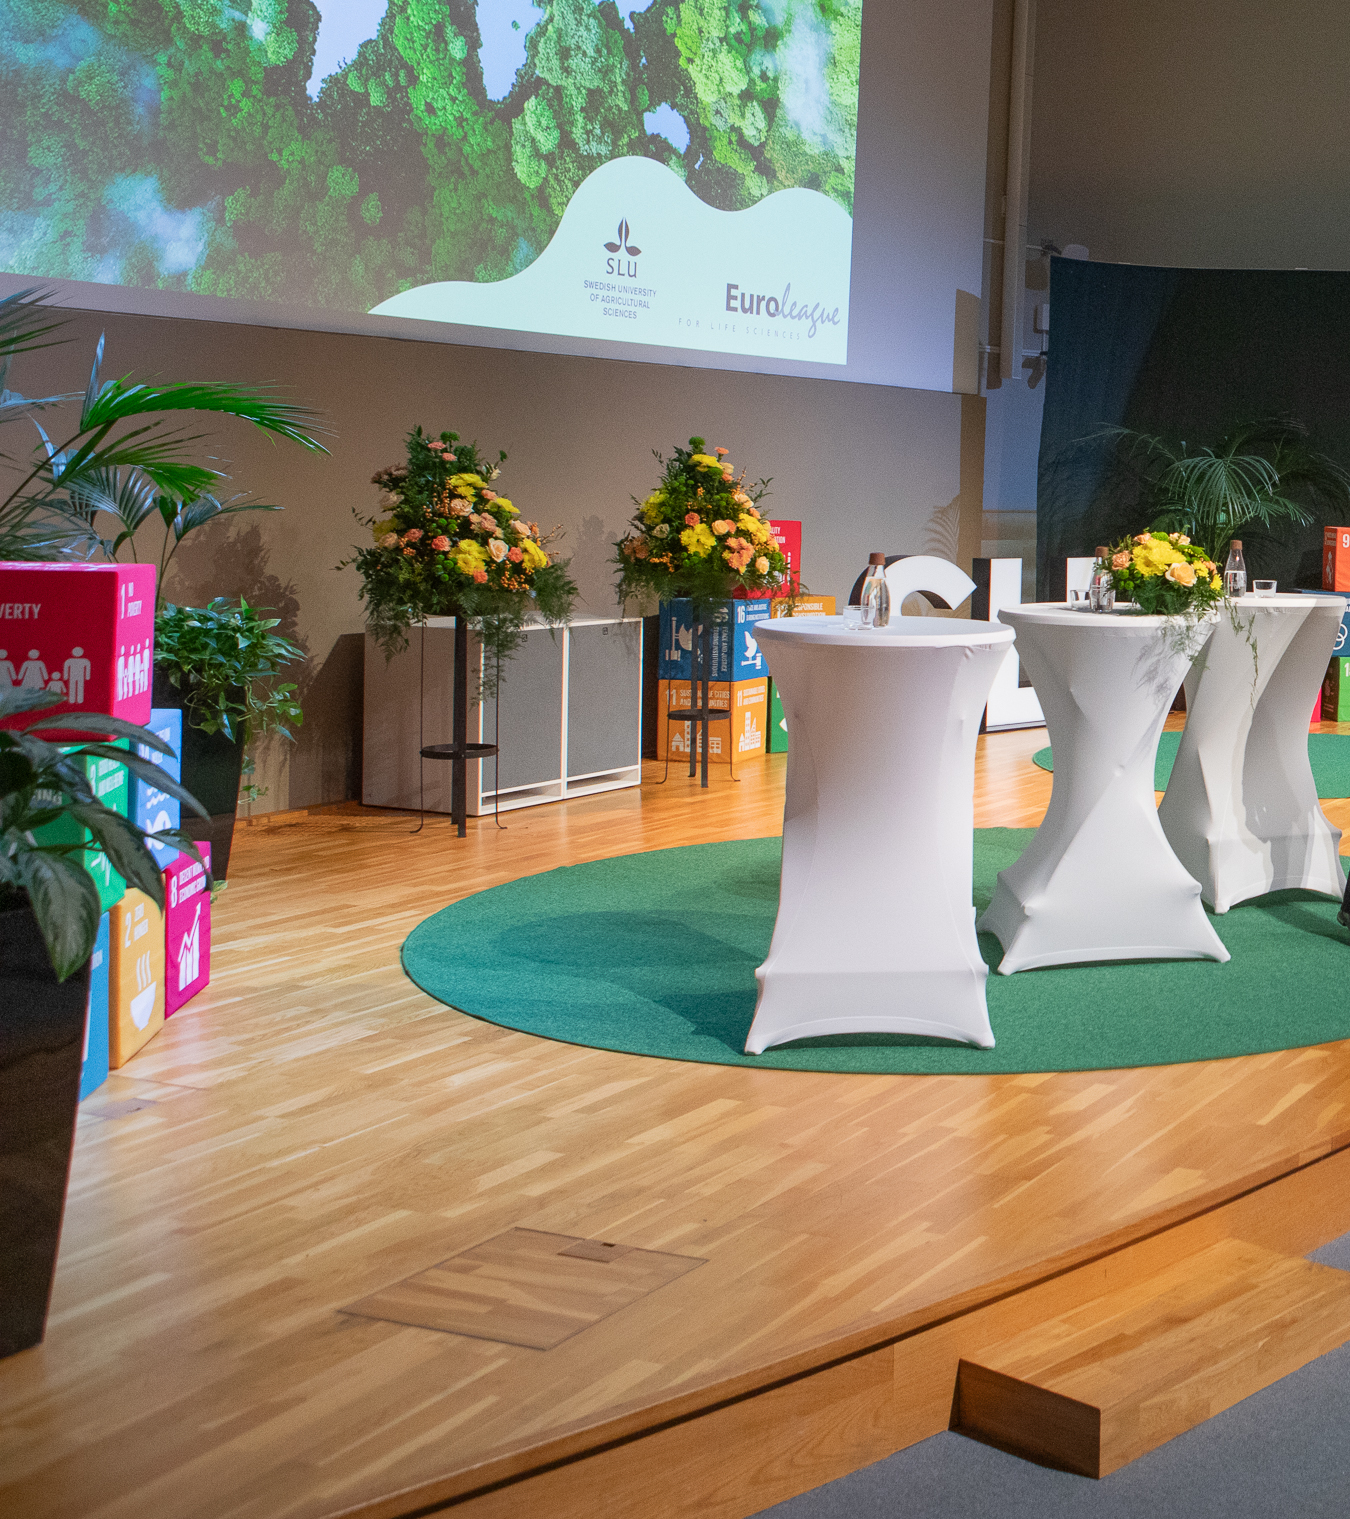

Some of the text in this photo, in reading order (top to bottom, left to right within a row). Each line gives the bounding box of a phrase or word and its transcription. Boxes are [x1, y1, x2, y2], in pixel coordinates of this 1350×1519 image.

[606, 258, 637, 279] SLU
[583, 279, 657, 298] SWEDISH UNIVERSITY
[589, 293, 650, 309] OF AGRICULTURAL
[725, 282, 840, 339] Euroleague
[602, 307, 637, 320] SCIENCES
[678, 318, 802, 341] FOR LIFE SCIENCES
[1342, 534, 1350, 548] 9
[737, 605, 746, 624] 16
[714, 690, 730, 699] CITIES
[737, 690, 742, 707] 11
[171, 875, 178, 909] 8
[125, 911, 132, 949] 2
